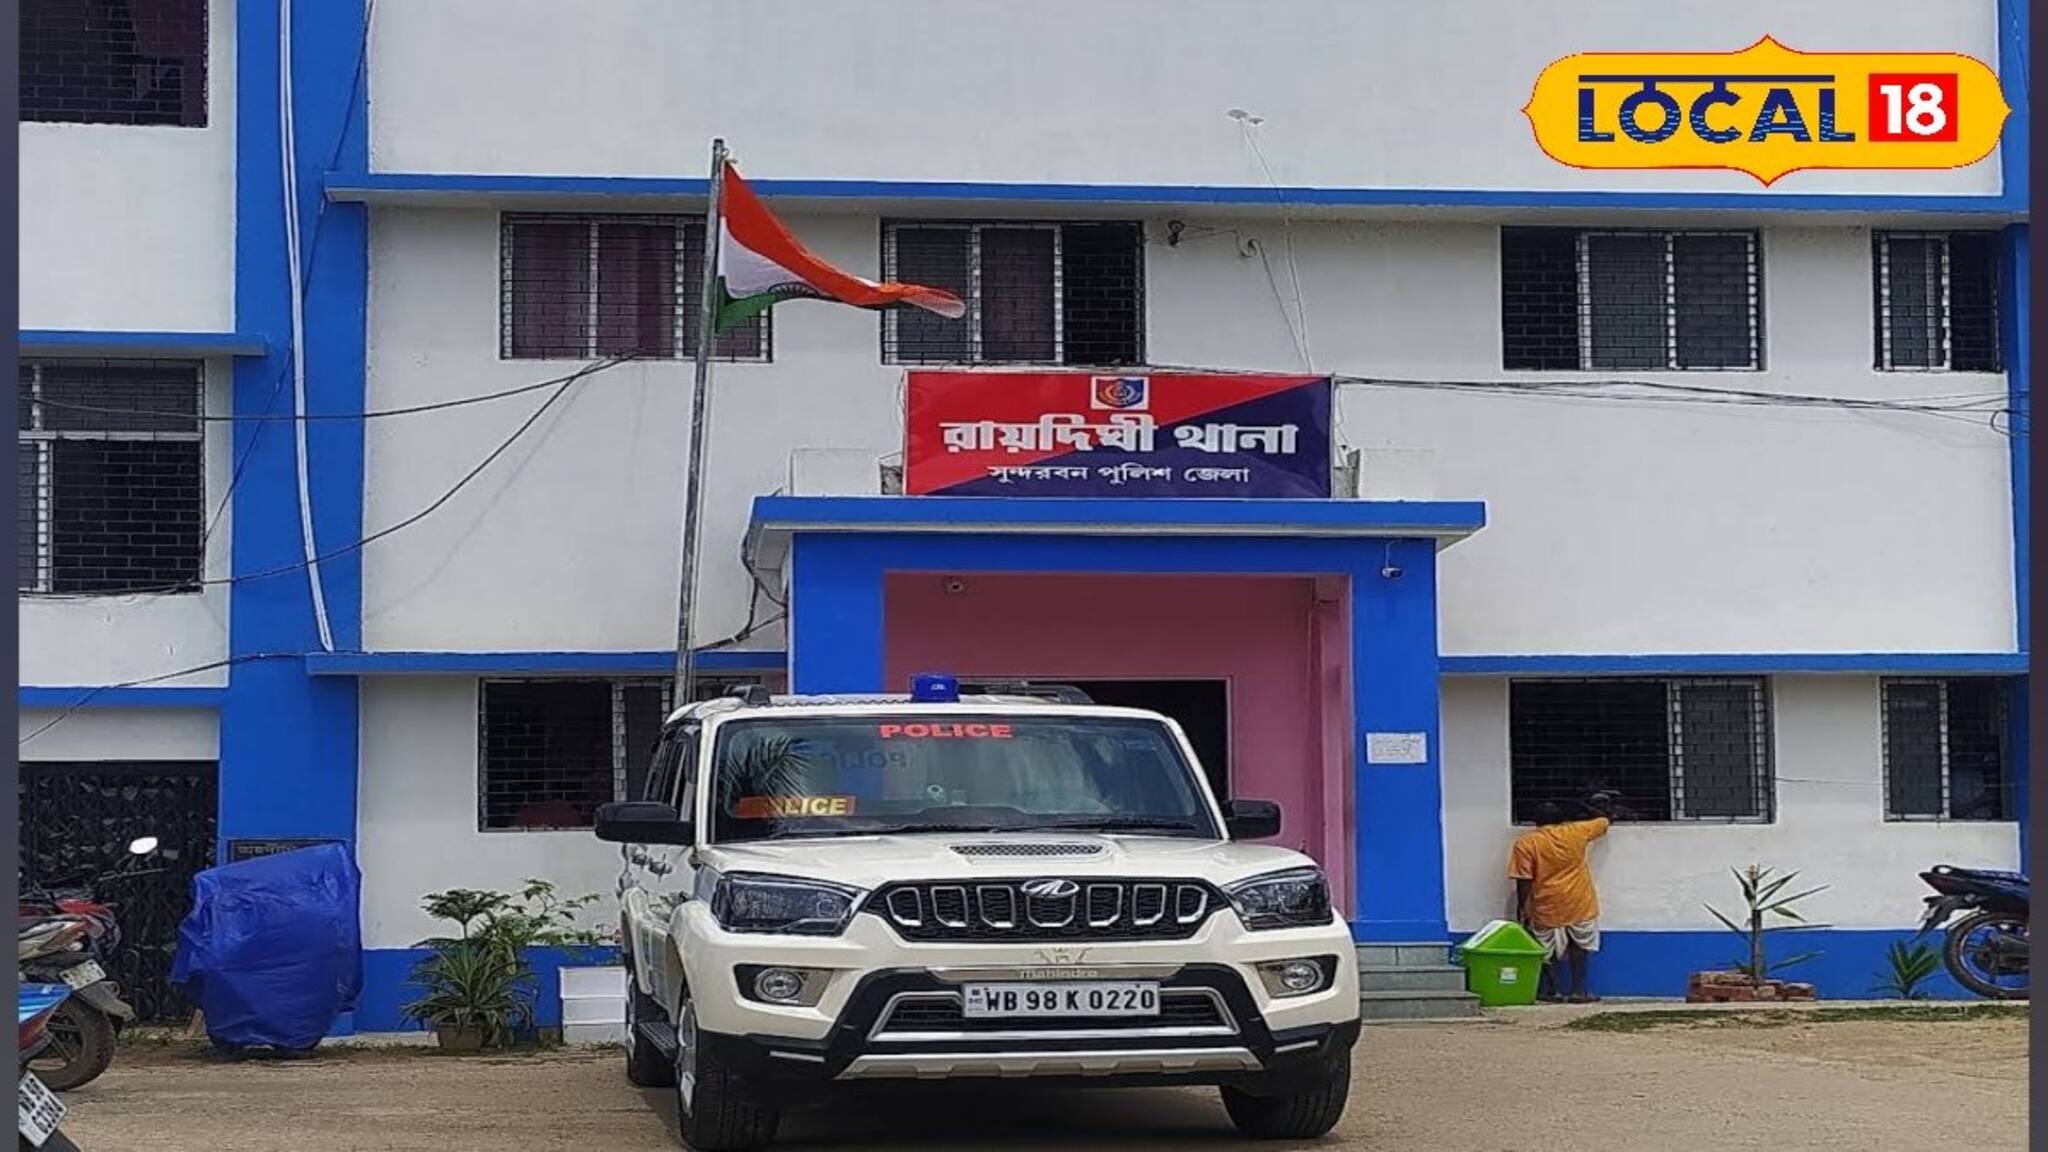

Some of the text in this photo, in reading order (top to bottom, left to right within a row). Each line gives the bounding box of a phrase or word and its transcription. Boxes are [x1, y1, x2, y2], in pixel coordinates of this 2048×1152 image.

[940, 413, 1299, 454] রায়দিঘী থানা
[987, 462, 1251, 486] সুন্দরবন পুলিশ জেলা
[880, 724, 1013, 738] POLICE
[768, 797, 847, 815] LICE
[986, 990, 1018, 1011] WB
[1026, 990, 1057, 1010] 98
[1066, 990, 1080, 1010] K
[1089, 989, 1155, 1009] 0220
